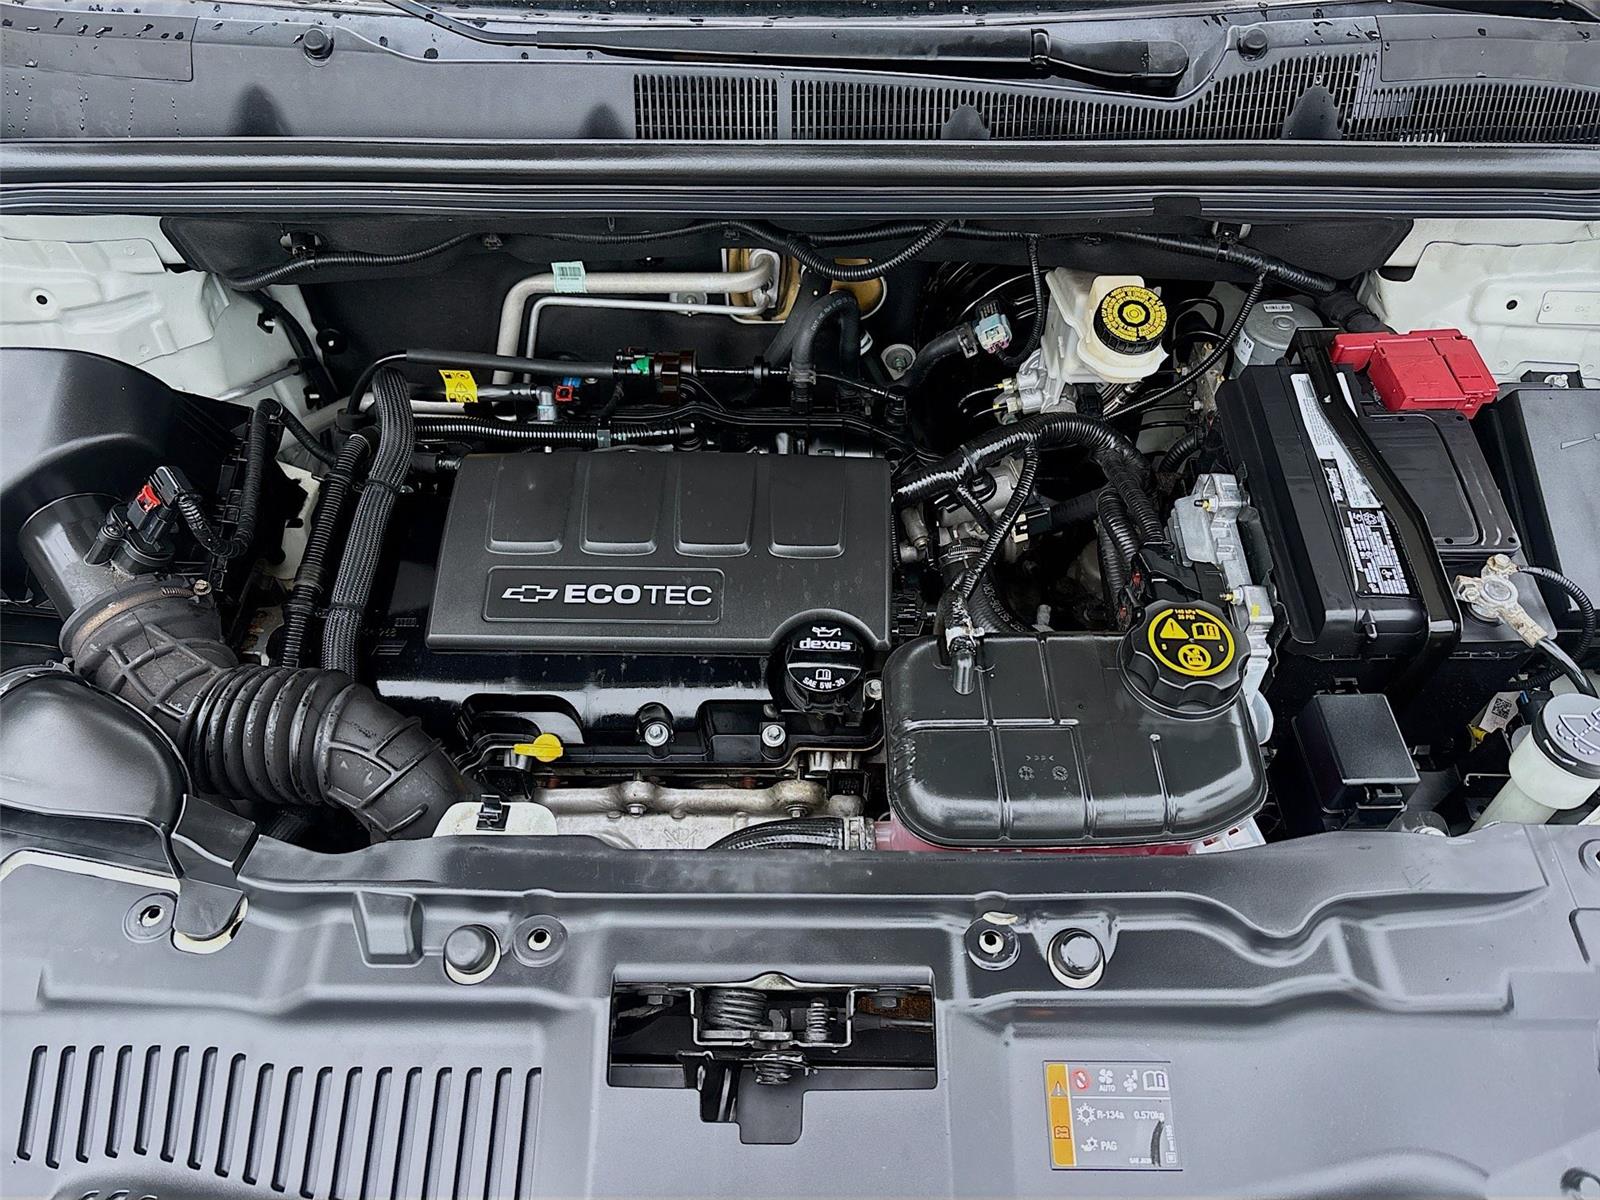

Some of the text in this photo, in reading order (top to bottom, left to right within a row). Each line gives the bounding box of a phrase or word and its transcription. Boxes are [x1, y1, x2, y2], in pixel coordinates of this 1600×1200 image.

[563, 584, 713, 606] ECOTEC
[799, 637, 852, 651] dexos
[802, 676, 846, 690] SAE 5W-30
[1096, 1110, 1165, 1122] R-134a 0.570kg
[1100, 1140, 1118, 1151] PAG
